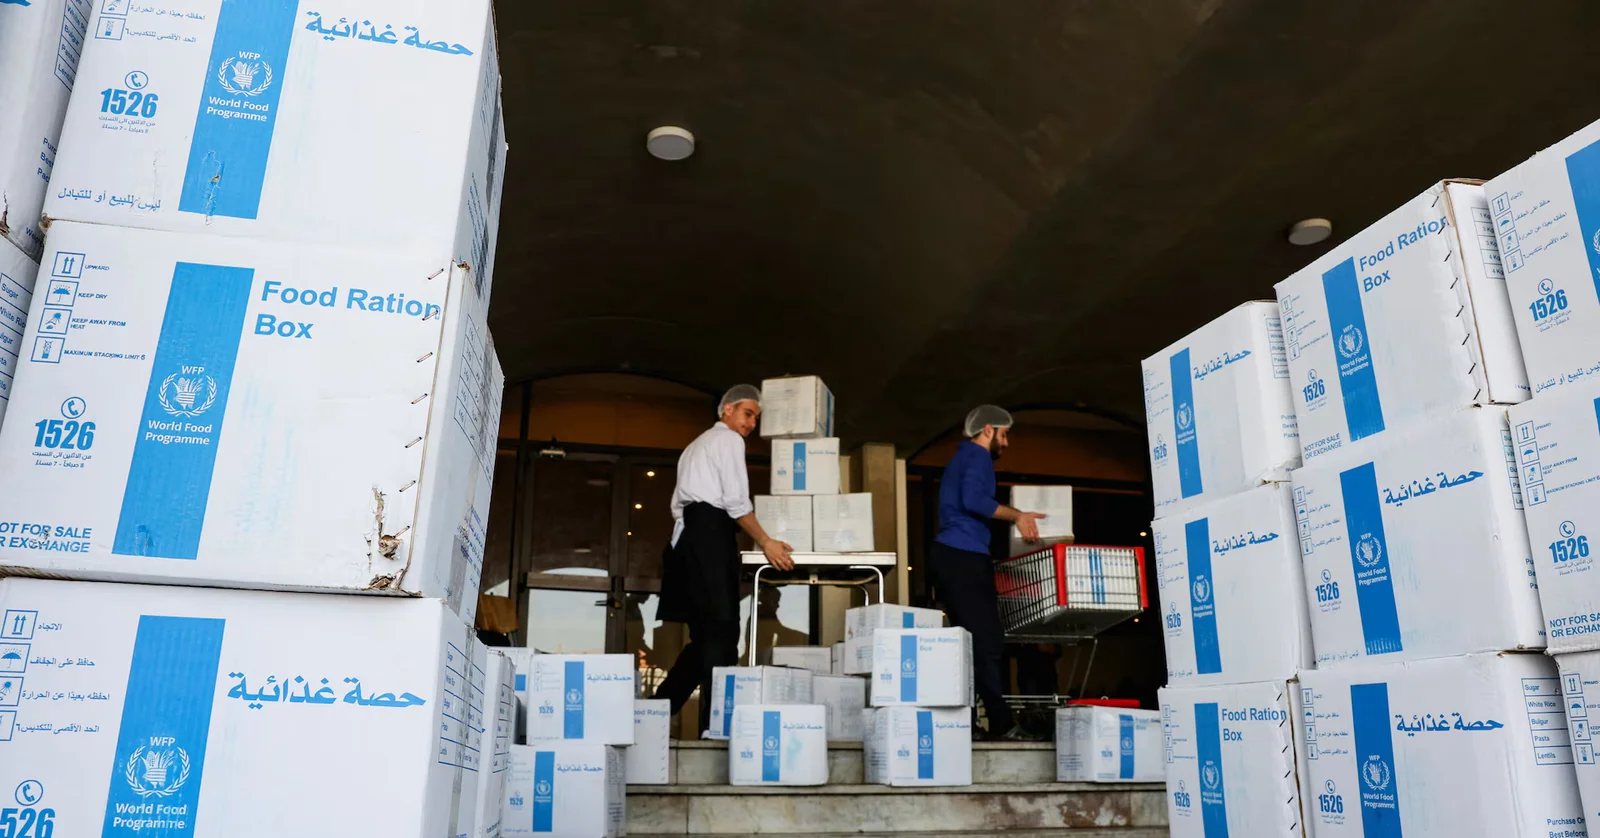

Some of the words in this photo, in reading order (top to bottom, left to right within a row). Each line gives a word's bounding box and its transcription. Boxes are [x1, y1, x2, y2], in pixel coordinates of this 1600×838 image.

[304, 10, 399, 45] غذائية
[403, 25, 474, 57] حصة
[61, 43, 75, 64] Pasta
[238, 50, 261, 61] WFP
[100, 88, 159, 119] 1526
[208, 96, 242, 109] World
[243, 101, 270, 112] Food
[206, 106, 268, 122] Programme
[57, 187, 91, 200] للتبادل
[1359, 242, 1395, 272] Food
[1397, 216, 1450, 251] Ration
[1362, 270, 1391, 293] Box
[1, 283, 19, 300] Sugar
[260, 280, 338, 308] Food
[345, 287, 441, 320] Ration
[1529, 288, 1568, 322] 1526
[253, 313, 315, 340] Box
[1342, 324, 1354, 333] WFP
[64, 349, 93, 357] MAXIMUM
[93, 351, 123, 359] STACKING
[1224, 349, 1252, 366] حصة
[181, 364, 205, 375] WFP
[1193, 356, 1224, 381] غذائية
[1340, 359, 1356, 371] World
[1354, 354, 1368, 364] Food
[1341, 362, 1369, 377] Programme
[1559, 373, 1566, 385] أو
[1567, 367, 1584, 383] للبيع
[1302, 379, 1325, 403] 1526
[1535, 378, 1556, 393] للتبادل
[33, 418, 96, 451] 1526
[147, 419, 183, 432] World
[184, 421, 213, 434] Food
[145, 431, 210, 446] Programme
[1304, 441, 1317, 453] NOT
[1314, 437, 1327, 448] FOR
[1326, 433, 1341, 445] SALE
[1153, 443, 1168, 462] 1526
[1304, 451, 1313, 460] OR
[1313, 440, 1342, 456] EXCHANGE
[1436, 469, 1484, 490] حصة
[1383, 477, 1437, 508] غذائية
[0, 522, 19, 534] OT
[21, 523, 52, 537] FOR
[54, 526, 92, 539] SALE
[1248, 530, 1280, 546] حصة
[1360, 532, 1372, 541] WFP
[9, 536, 91, 553] EXCHANGE
[1213, 534, 1248, 556] غذائية
[1548, 535, 1590, 564] 1526
[1357, 570, 1373, 579] World
[1373, 566, 1387, 576] Food
[1358, 575, 1387, 586] Programme
[1315, 581, 1340, 603] 1526
[1165, 612, 1182, 629] 1526
[1549, 617, 1567, 628] NOT
[1569, 614, 1588, 625] FOR
[1551, 628, 1564, 638] OR
[226, 671, 338, 710] غذائية
[342, 676, 427, 708] حصة
[1524, 684, 1540, 692] Sugar
[538, 706, 554, 714] 1526
[1221, 708, 1247, 721] Food
[1249, 707, 1287, 721] Ration
[1394, 713, 1451, 737] غذائية
[1451, 712, 1505, 731] حصة
[1531, 718, 1549, 726] Bulgur
[149, 735, 176, 747] WFP
[1223, 728, 1243, 741] Box
[1537, 752, 1556, 760] Lentils
[509, 796, 524, 806] 1526
[1173, 792, 1190, 808] 1526
[1318, 794, 1344, 814] 1526
[1363, 792, 1379, 801] World
[1379, 792, 1394, 801] Food
[115, 801, 154, 816] World
[156, 803, 188, 816] Food
[1363, 800, 1395, 810] Programme
[113, 815, 186, 831] Programme
[1547, 818, 1576, 826] Purchase
